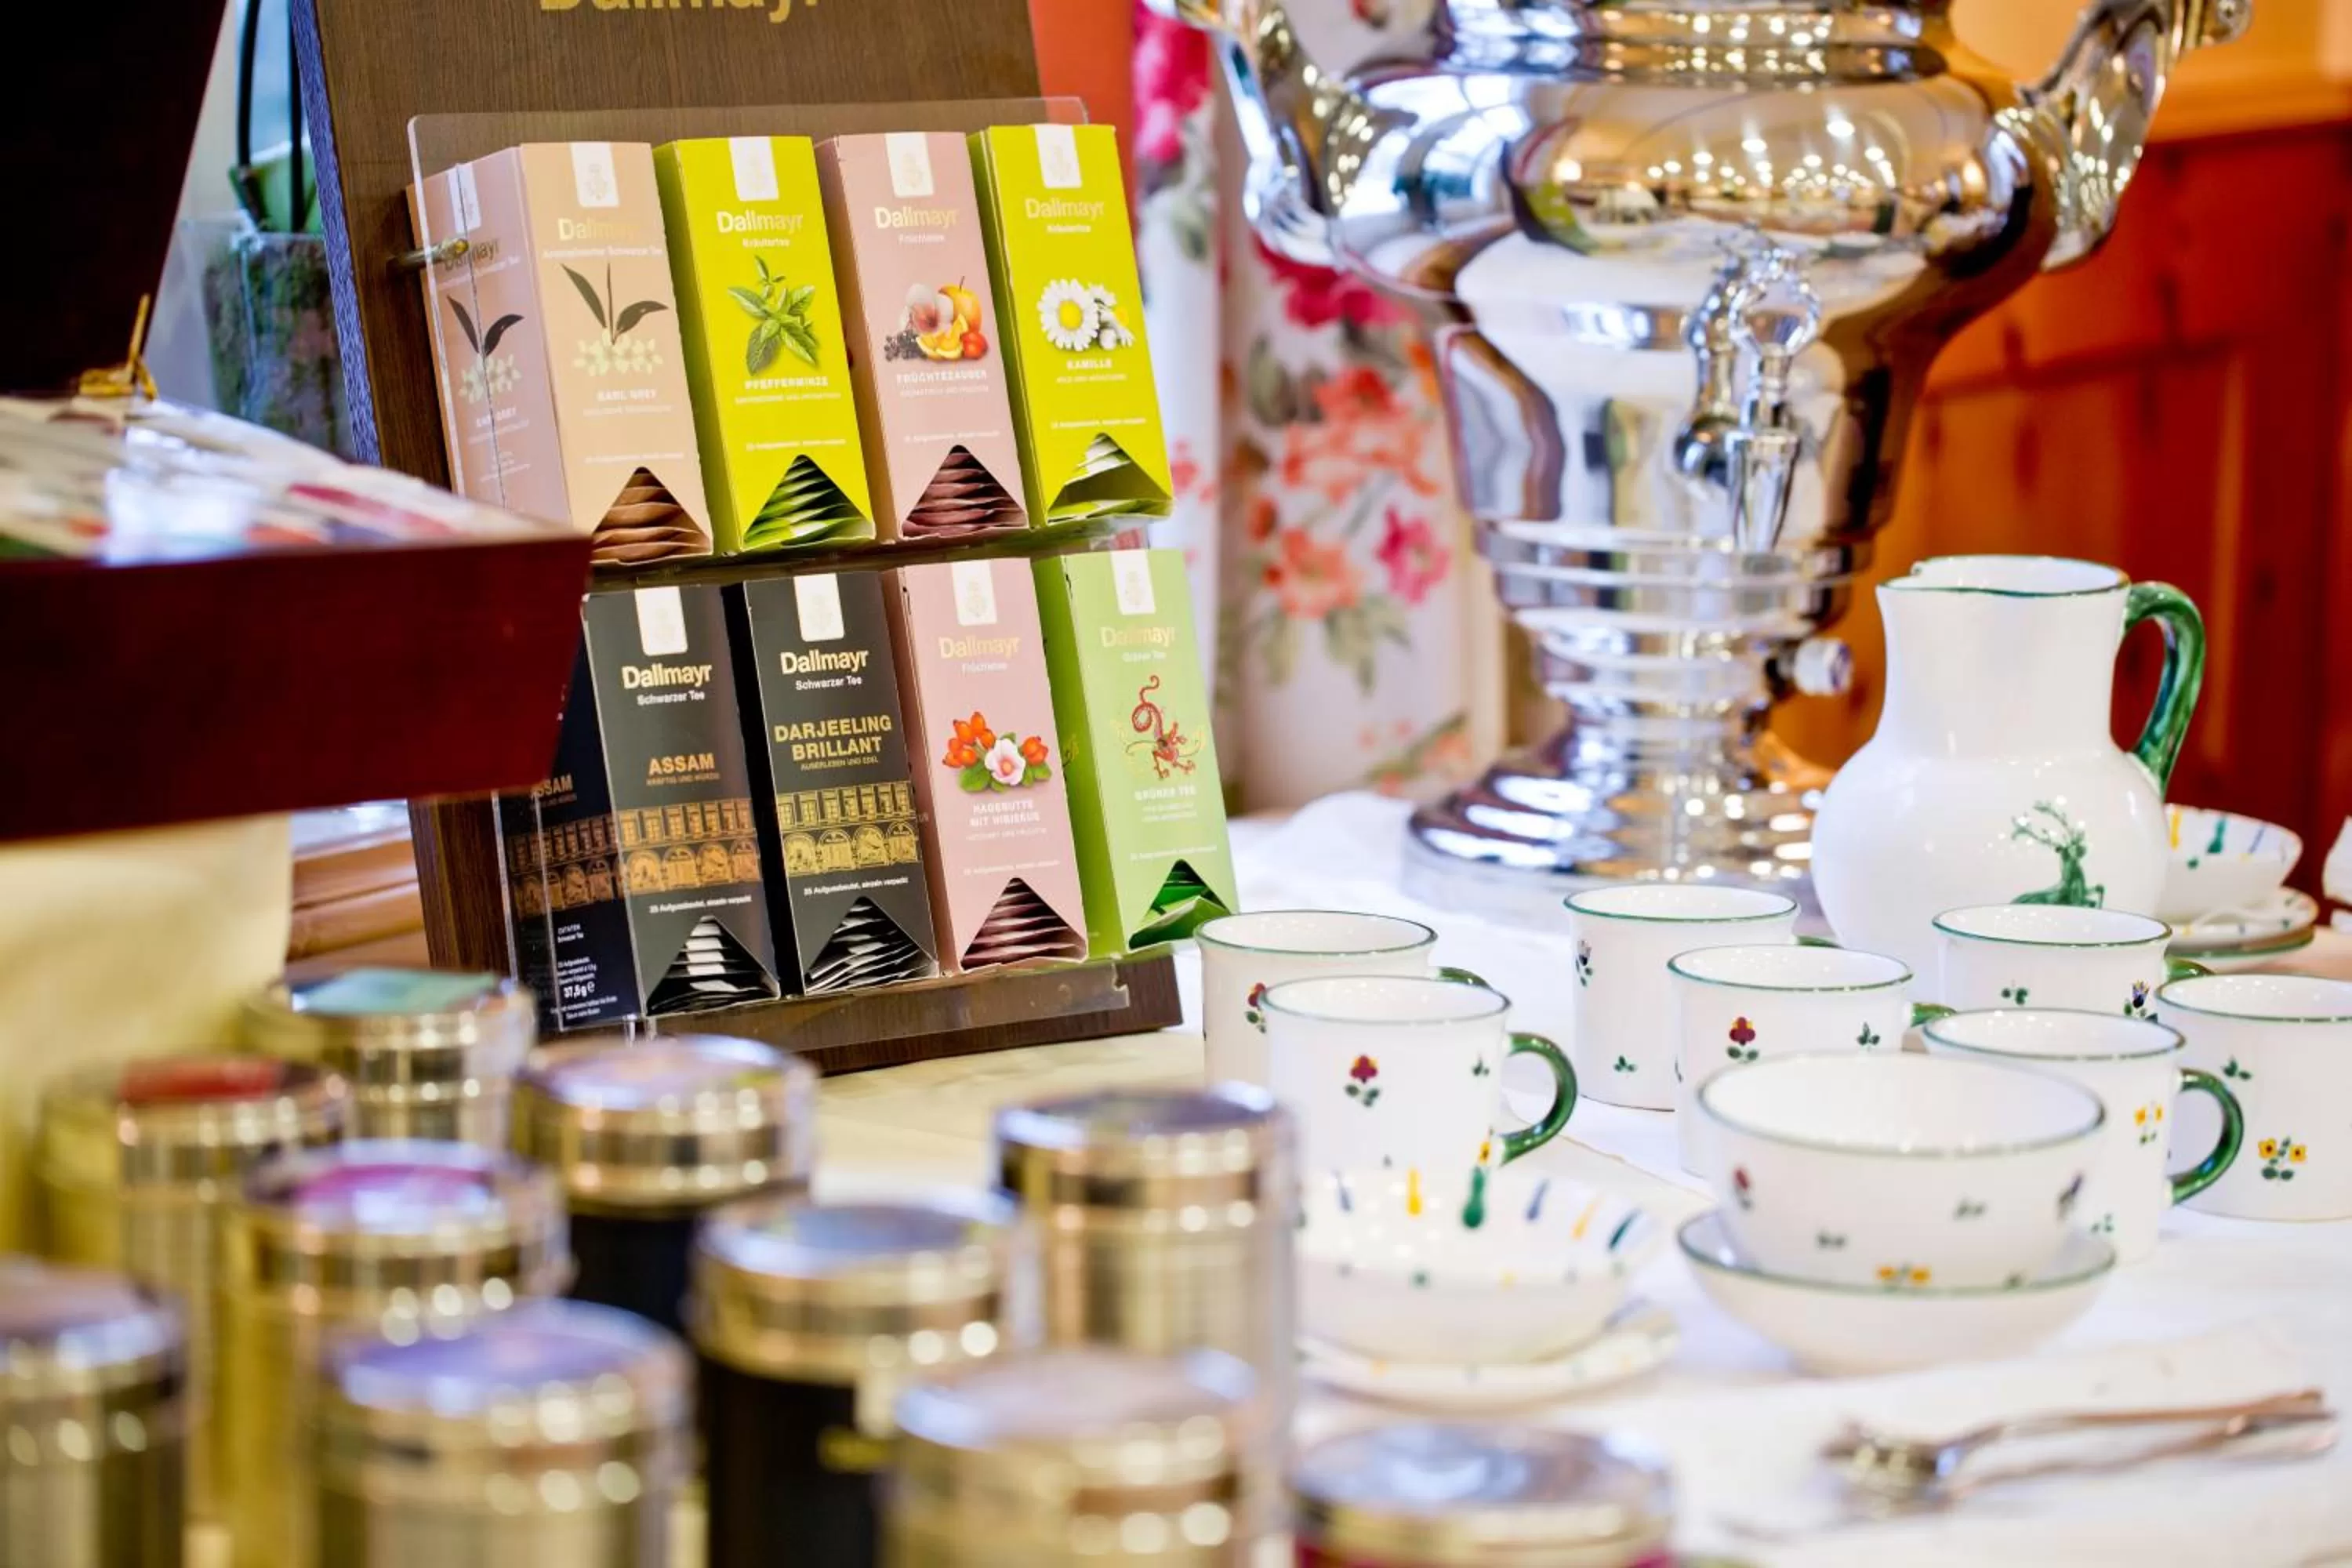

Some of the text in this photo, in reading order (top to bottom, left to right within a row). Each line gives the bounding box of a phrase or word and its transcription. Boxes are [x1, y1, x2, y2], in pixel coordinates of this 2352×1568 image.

[873, 205, 960, 230] Dallmayr
[1024, 197, 1105, 221] Dallmayr
[557, 216, 641, 241] Dallm
[716, 209, 803, 235] Dallmayr
[938, 634, 1020, 659] Dallmayr
[780, 648, 869, 675] Dallmayr
[622, 662, 713, 689] Dallmayr
[796, 674, 862, 691] Schwarzer Tee
[637, 689, 705, 706] Schwarzer Tee
[773, 714, 893, 743] DARJEELING
[791, 735, 882, 762] BRILLANT
[648, 752, 716, 776] ASSAM
